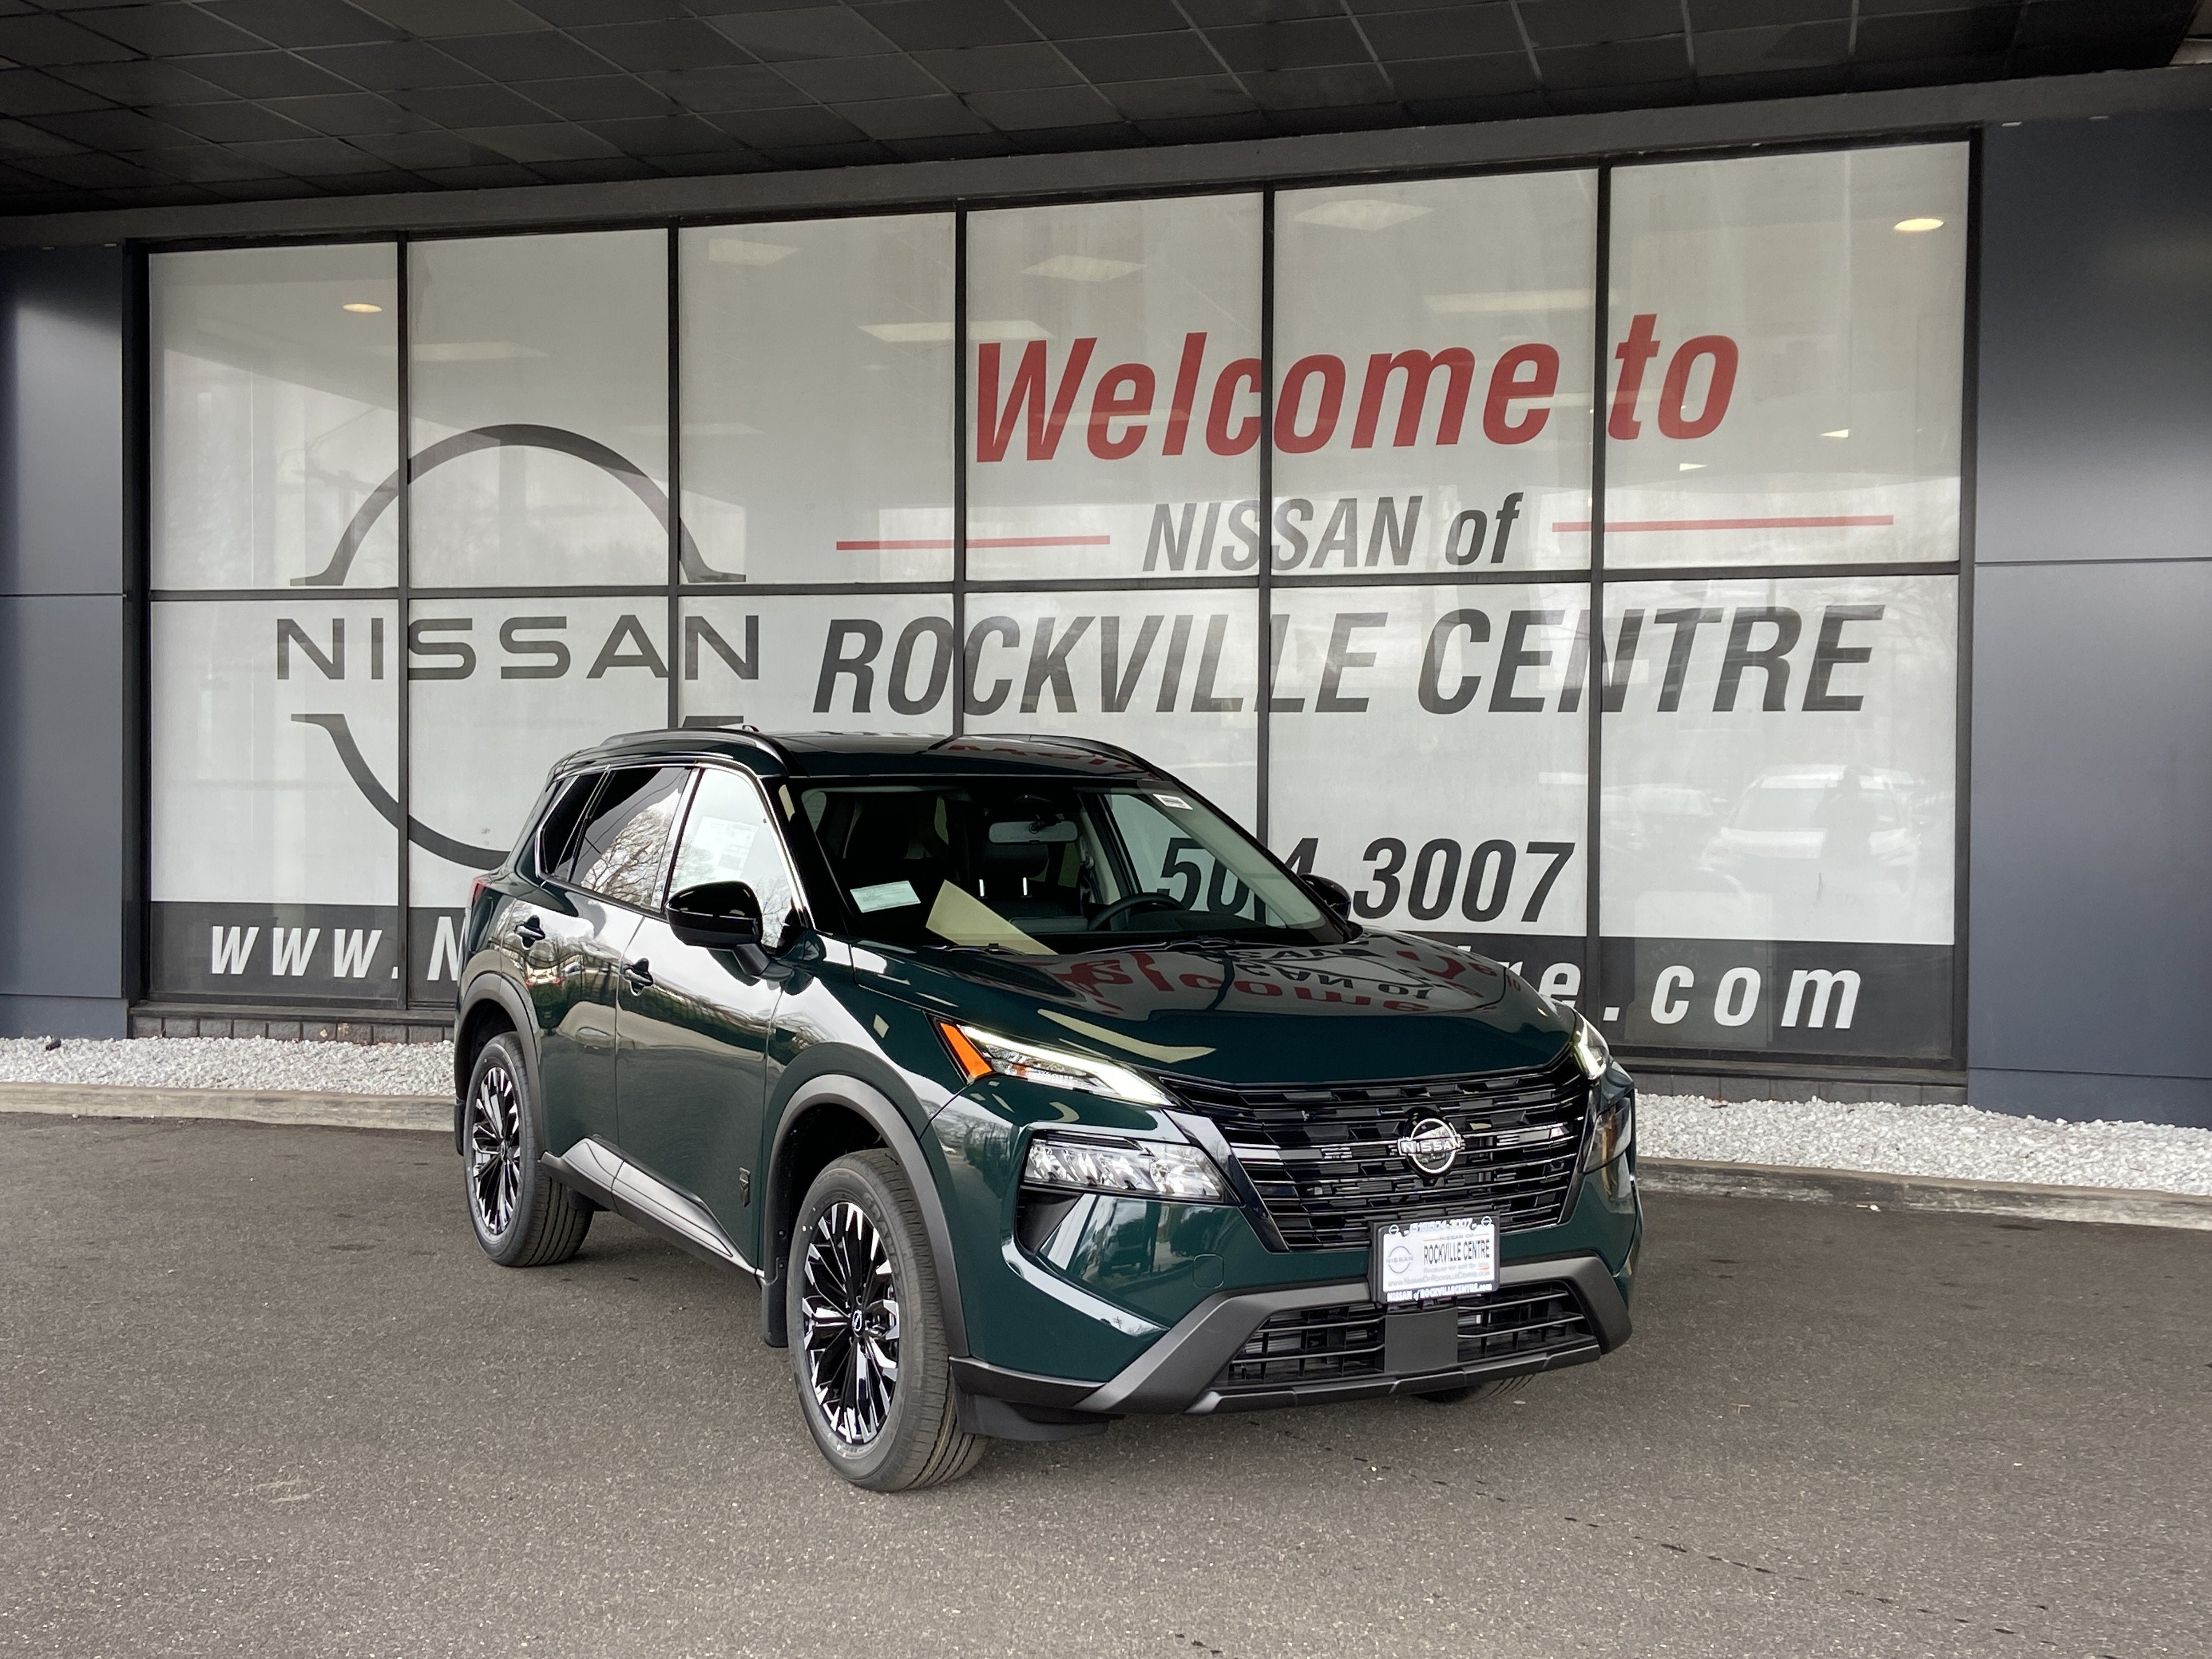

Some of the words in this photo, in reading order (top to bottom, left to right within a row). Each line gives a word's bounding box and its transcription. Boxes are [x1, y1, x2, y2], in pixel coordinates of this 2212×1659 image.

[976, 332, 1559, 462] Welcome
[1607, 314, 1739, 441] to
[1142, 495, 1423, 571] NISSAN
[1444, 492, 1523, 565] of
[277, 615, 759, 680] NISSAN
[812, 611, 1387, 715] ROCKVILLE
[1418, 604, 1884, 715] CENTRE
[1402, 1137, 1460, 1153] NISSAN
[1423, 1242, 1462, 1265] ROCKVILLE
[1463, 1239, 1490, 1260] CENTRE
[1387, 1290, 1413, 1302] NISSAN
